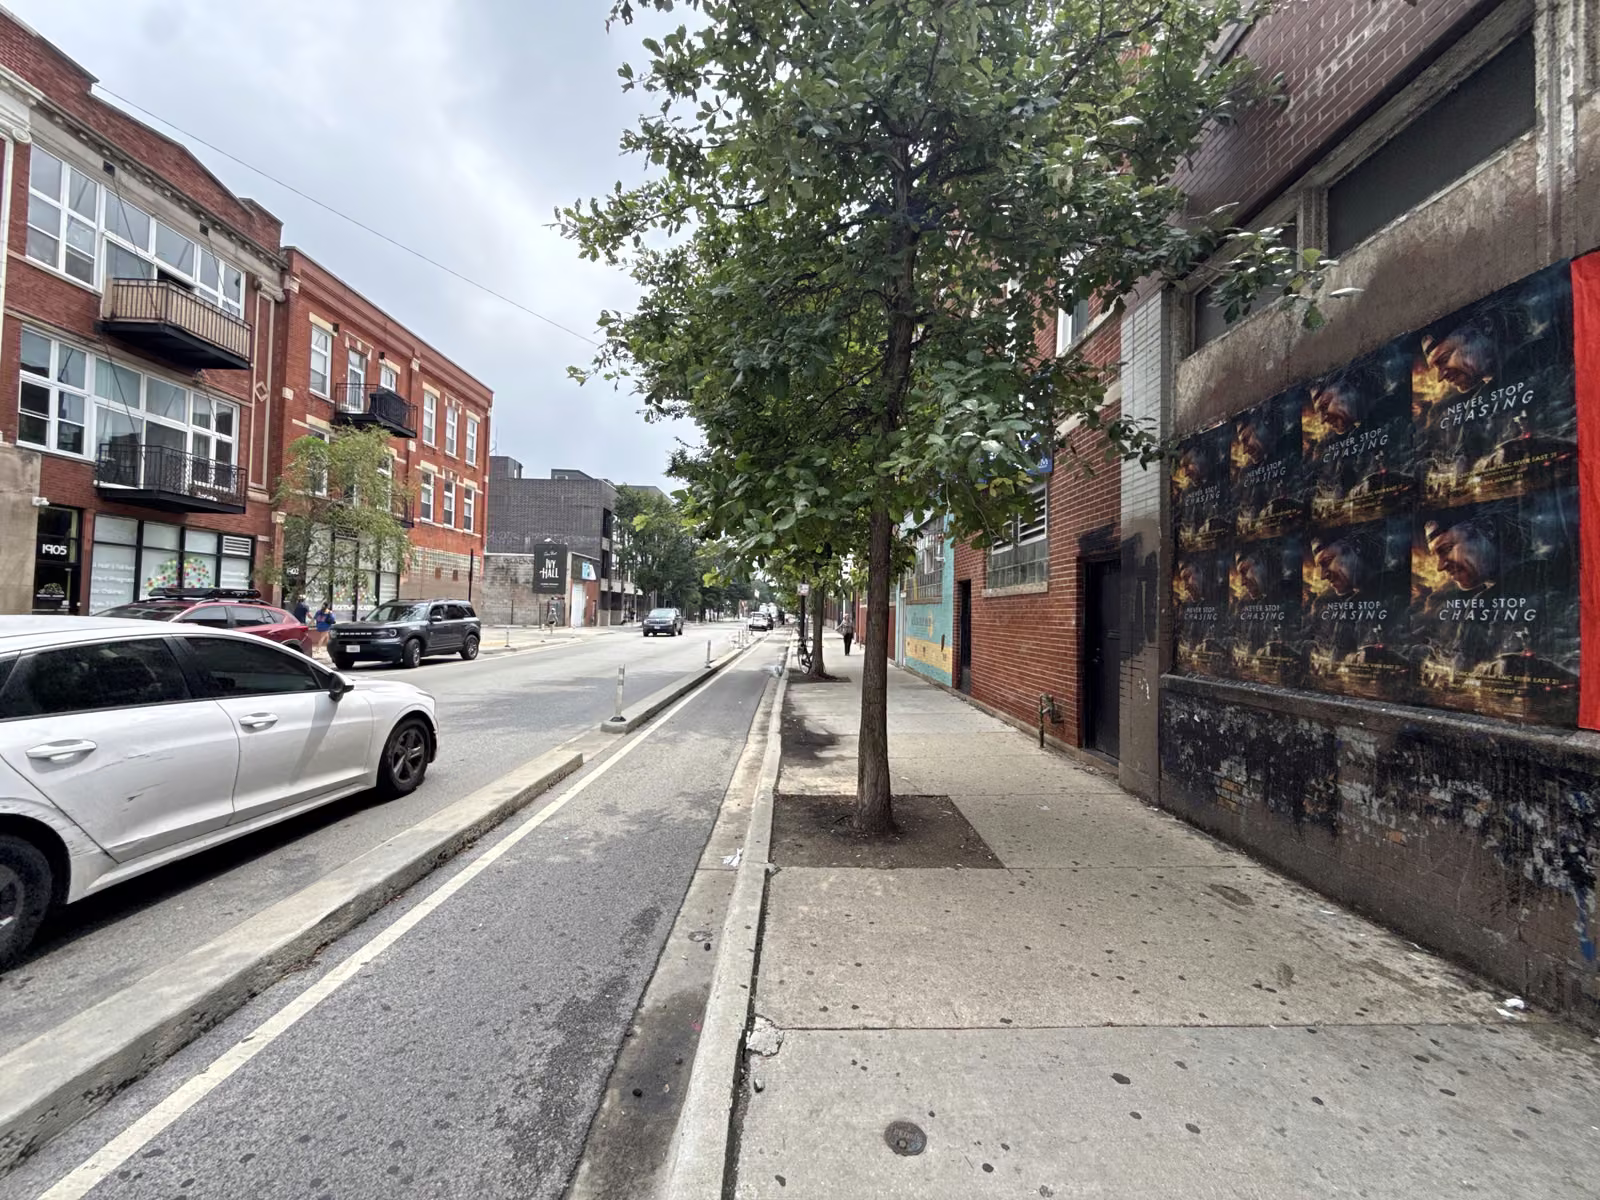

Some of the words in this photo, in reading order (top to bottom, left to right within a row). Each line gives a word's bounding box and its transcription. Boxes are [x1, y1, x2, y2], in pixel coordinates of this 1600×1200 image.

[1447, 396, 1484, 416] NEVER
[1491, 382, 1524, 401] STOP
[1440, 390, 1535, 430] CHASING
[1328, 437, 1355, 452] NEVER
[1360, 428, 1382, 442] STOP
[1322, 434, 1389, 463] CHASING
[1532, 454, 1548, 463] EAST
[1243, 466, 1286, 488] CHASING
[42, 543, 68, 555] 1905
[545, 558, 556, 569] IVY
[539, 567, 559, 579] HALL
[1264, 604, 1280, 612] STOP
[1327, 601, 1354, 610] NEVER
[1358, 600, 1381, 610] STOP
[1446, 598, 1485, 609] NEVER
[1491, 598, 1527, 608] STOP
[1240, 611, 1285, 621] CHASING
[1321, 609, 1388, 620] CHASING
[1439, 609, 1537, 621] CHASING
